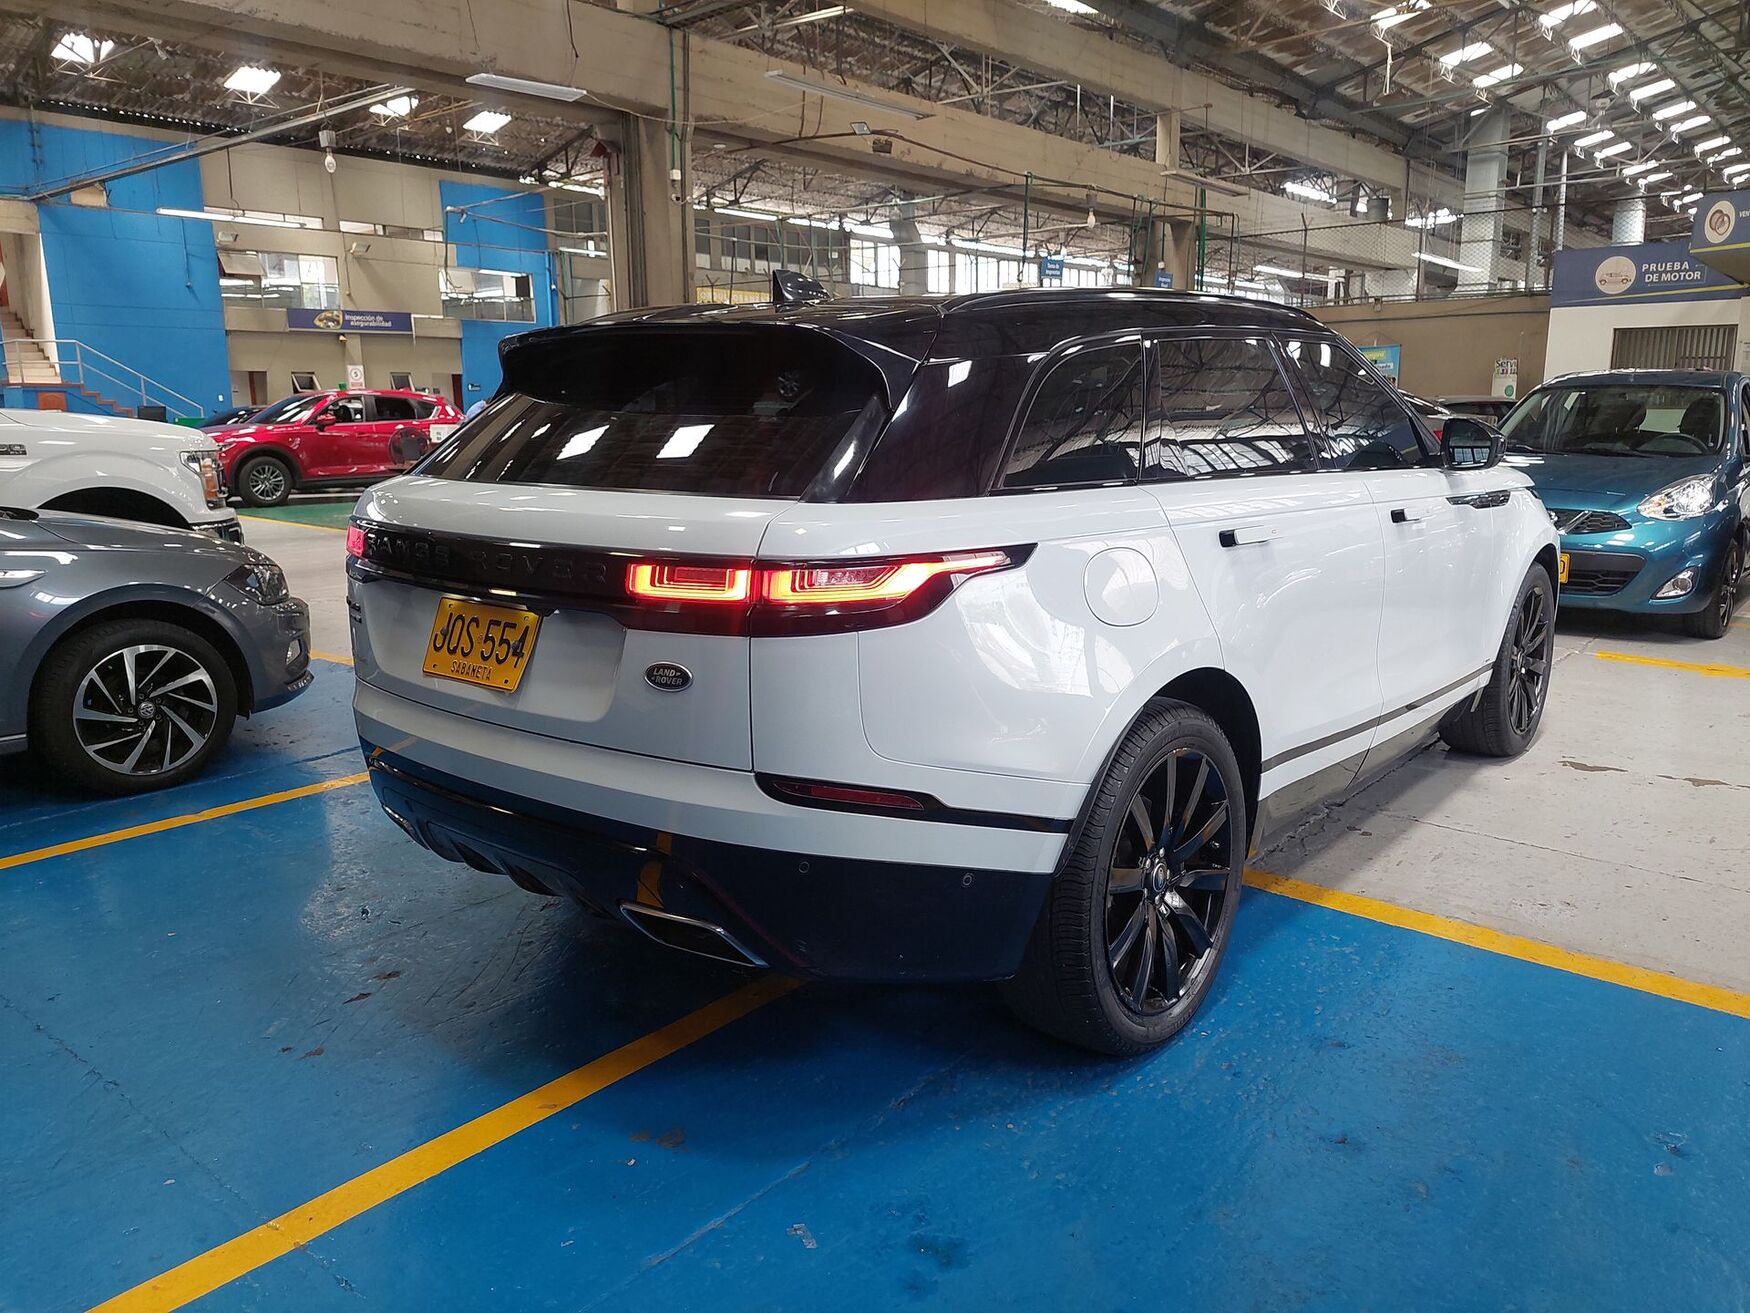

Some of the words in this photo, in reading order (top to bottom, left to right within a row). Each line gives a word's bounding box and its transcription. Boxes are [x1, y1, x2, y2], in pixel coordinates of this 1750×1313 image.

[1641, 260, 1690, 272] PRUEBA
[1645, 273, 1659, 283] DE
[1661, 270, 1702, 282] MOTOR
[345, 313, 375, 322] Inspección
[469, 549, 607, 585] ROVER
[432, 611, 480, 657] JQS
[480, 618, 530, 669] 554
[450, 659, 492, 681] SABANETA
[653, 667, 676, 677] LAND
[655, 675, 683, 686] ROVER
